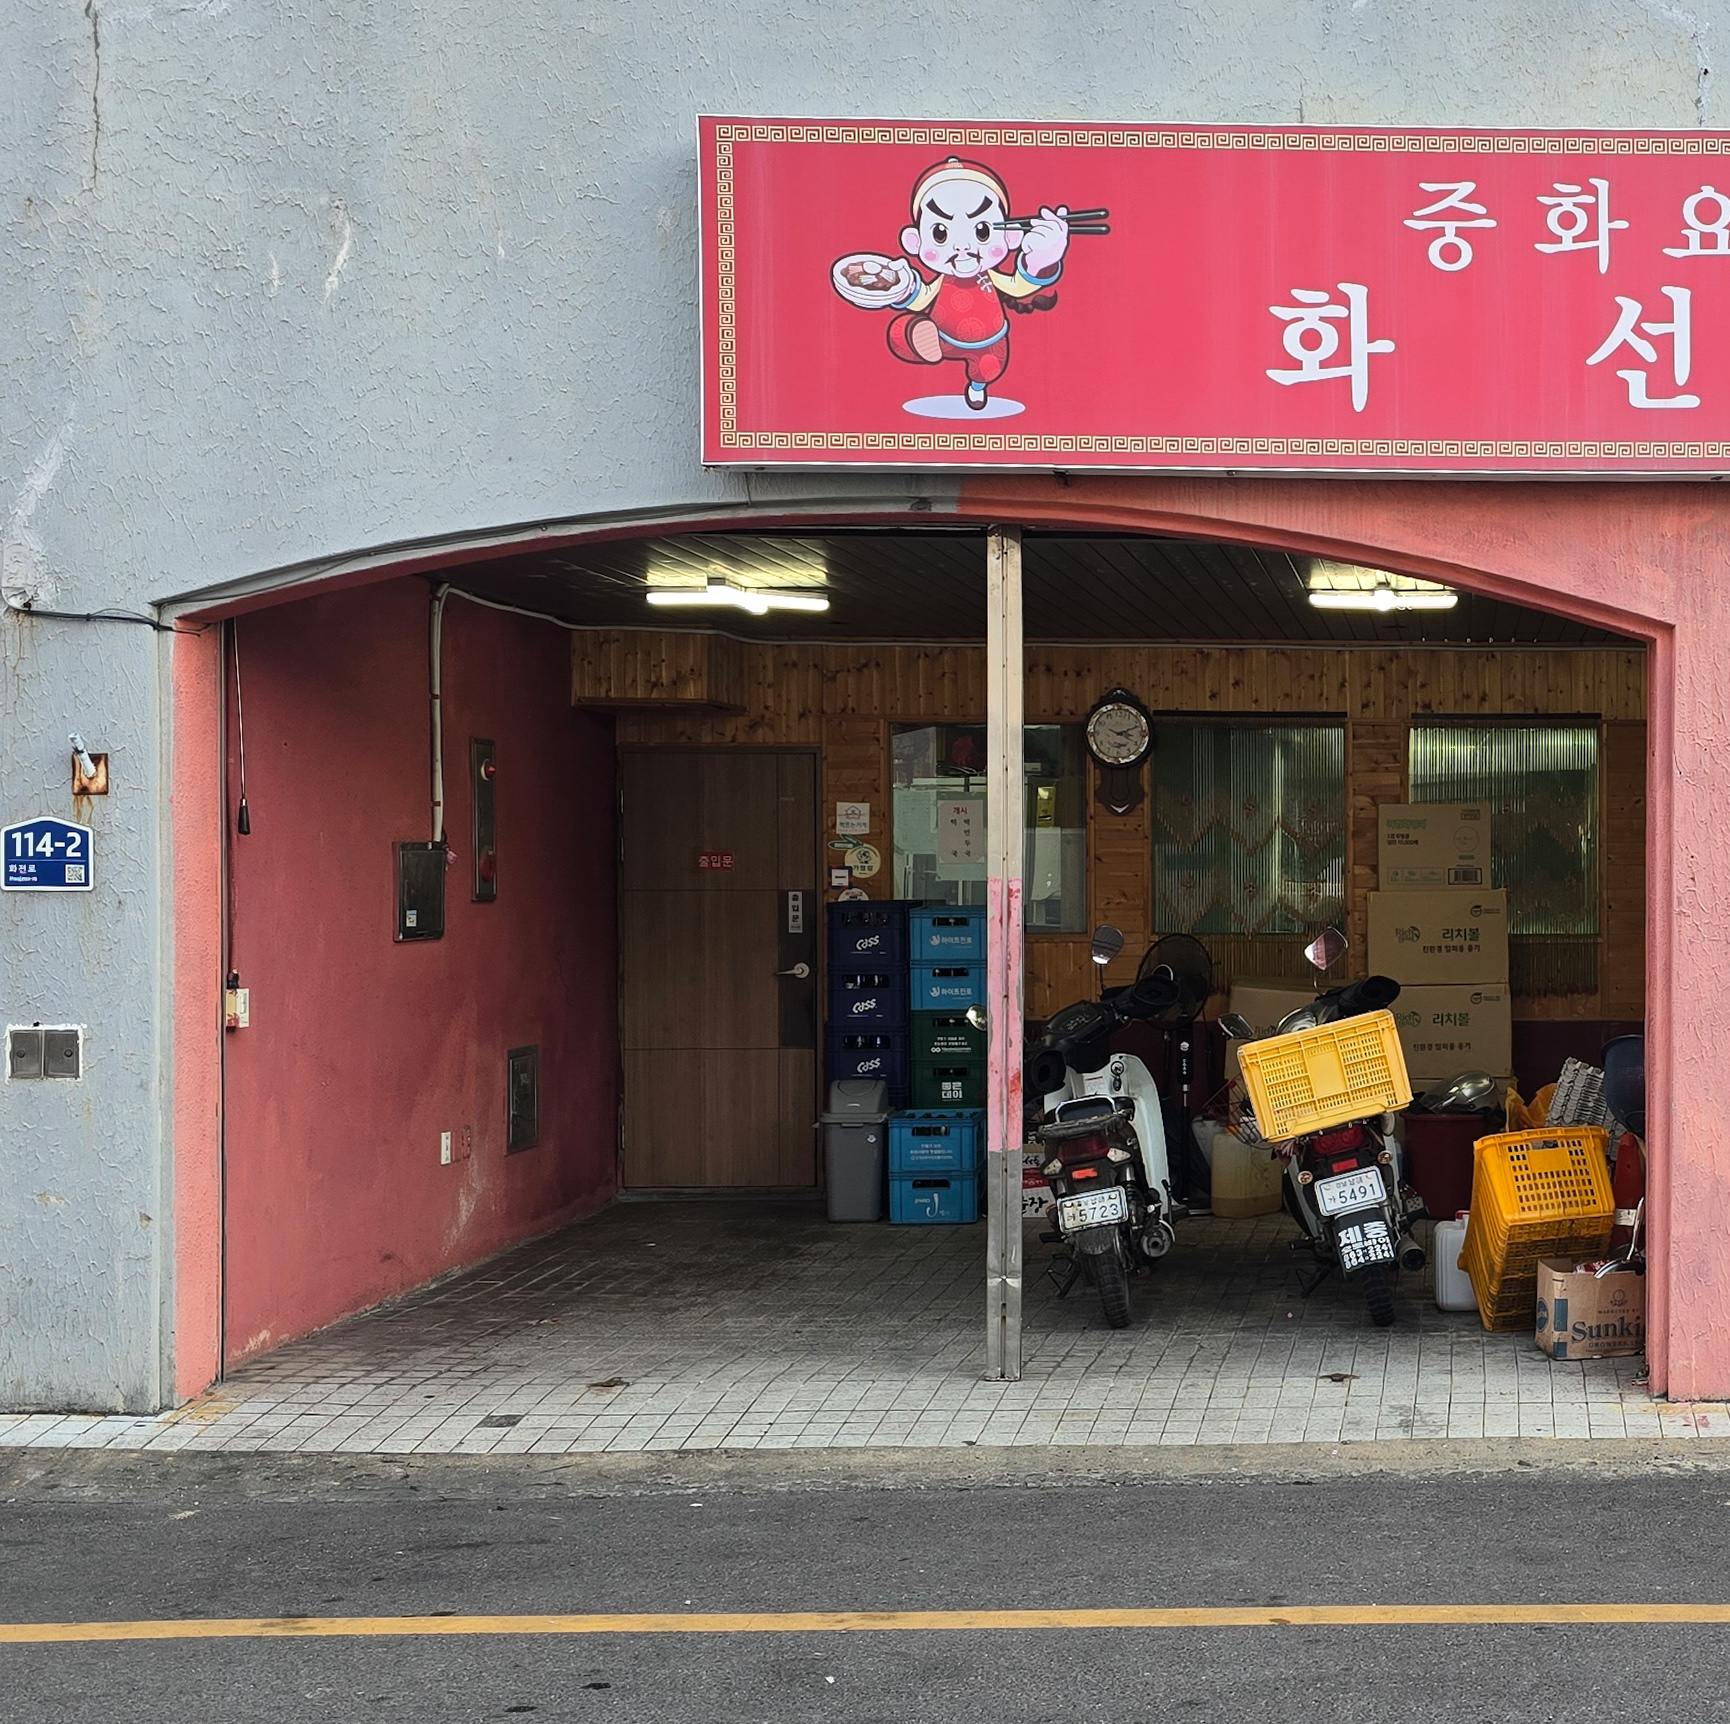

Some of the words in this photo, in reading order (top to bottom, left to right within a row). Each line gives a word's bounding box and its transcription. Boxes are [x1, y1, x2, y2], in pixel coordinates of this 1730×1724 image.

[953, 807, 967, 815] 개시
[12, 832, 81, 857] 114-2
[699, 855, 733, 868] 출입문
[8, 864, 37, 874] 화전로
[791, 894, 800, 922] 출입문
[941, 936, 972, 944] 하이트진로
[1442, 927, 1480, 941] 리치볼
[941, 987, 972, 995] 하이트진로
[1432, 1012, 1470, 1026] 리치볼
[1339, 1184, 1376, 1204] 5491
[1079, 1203, 1119, 1222] 5723
[1341, 1236, 1389, 1255] 오토바이
